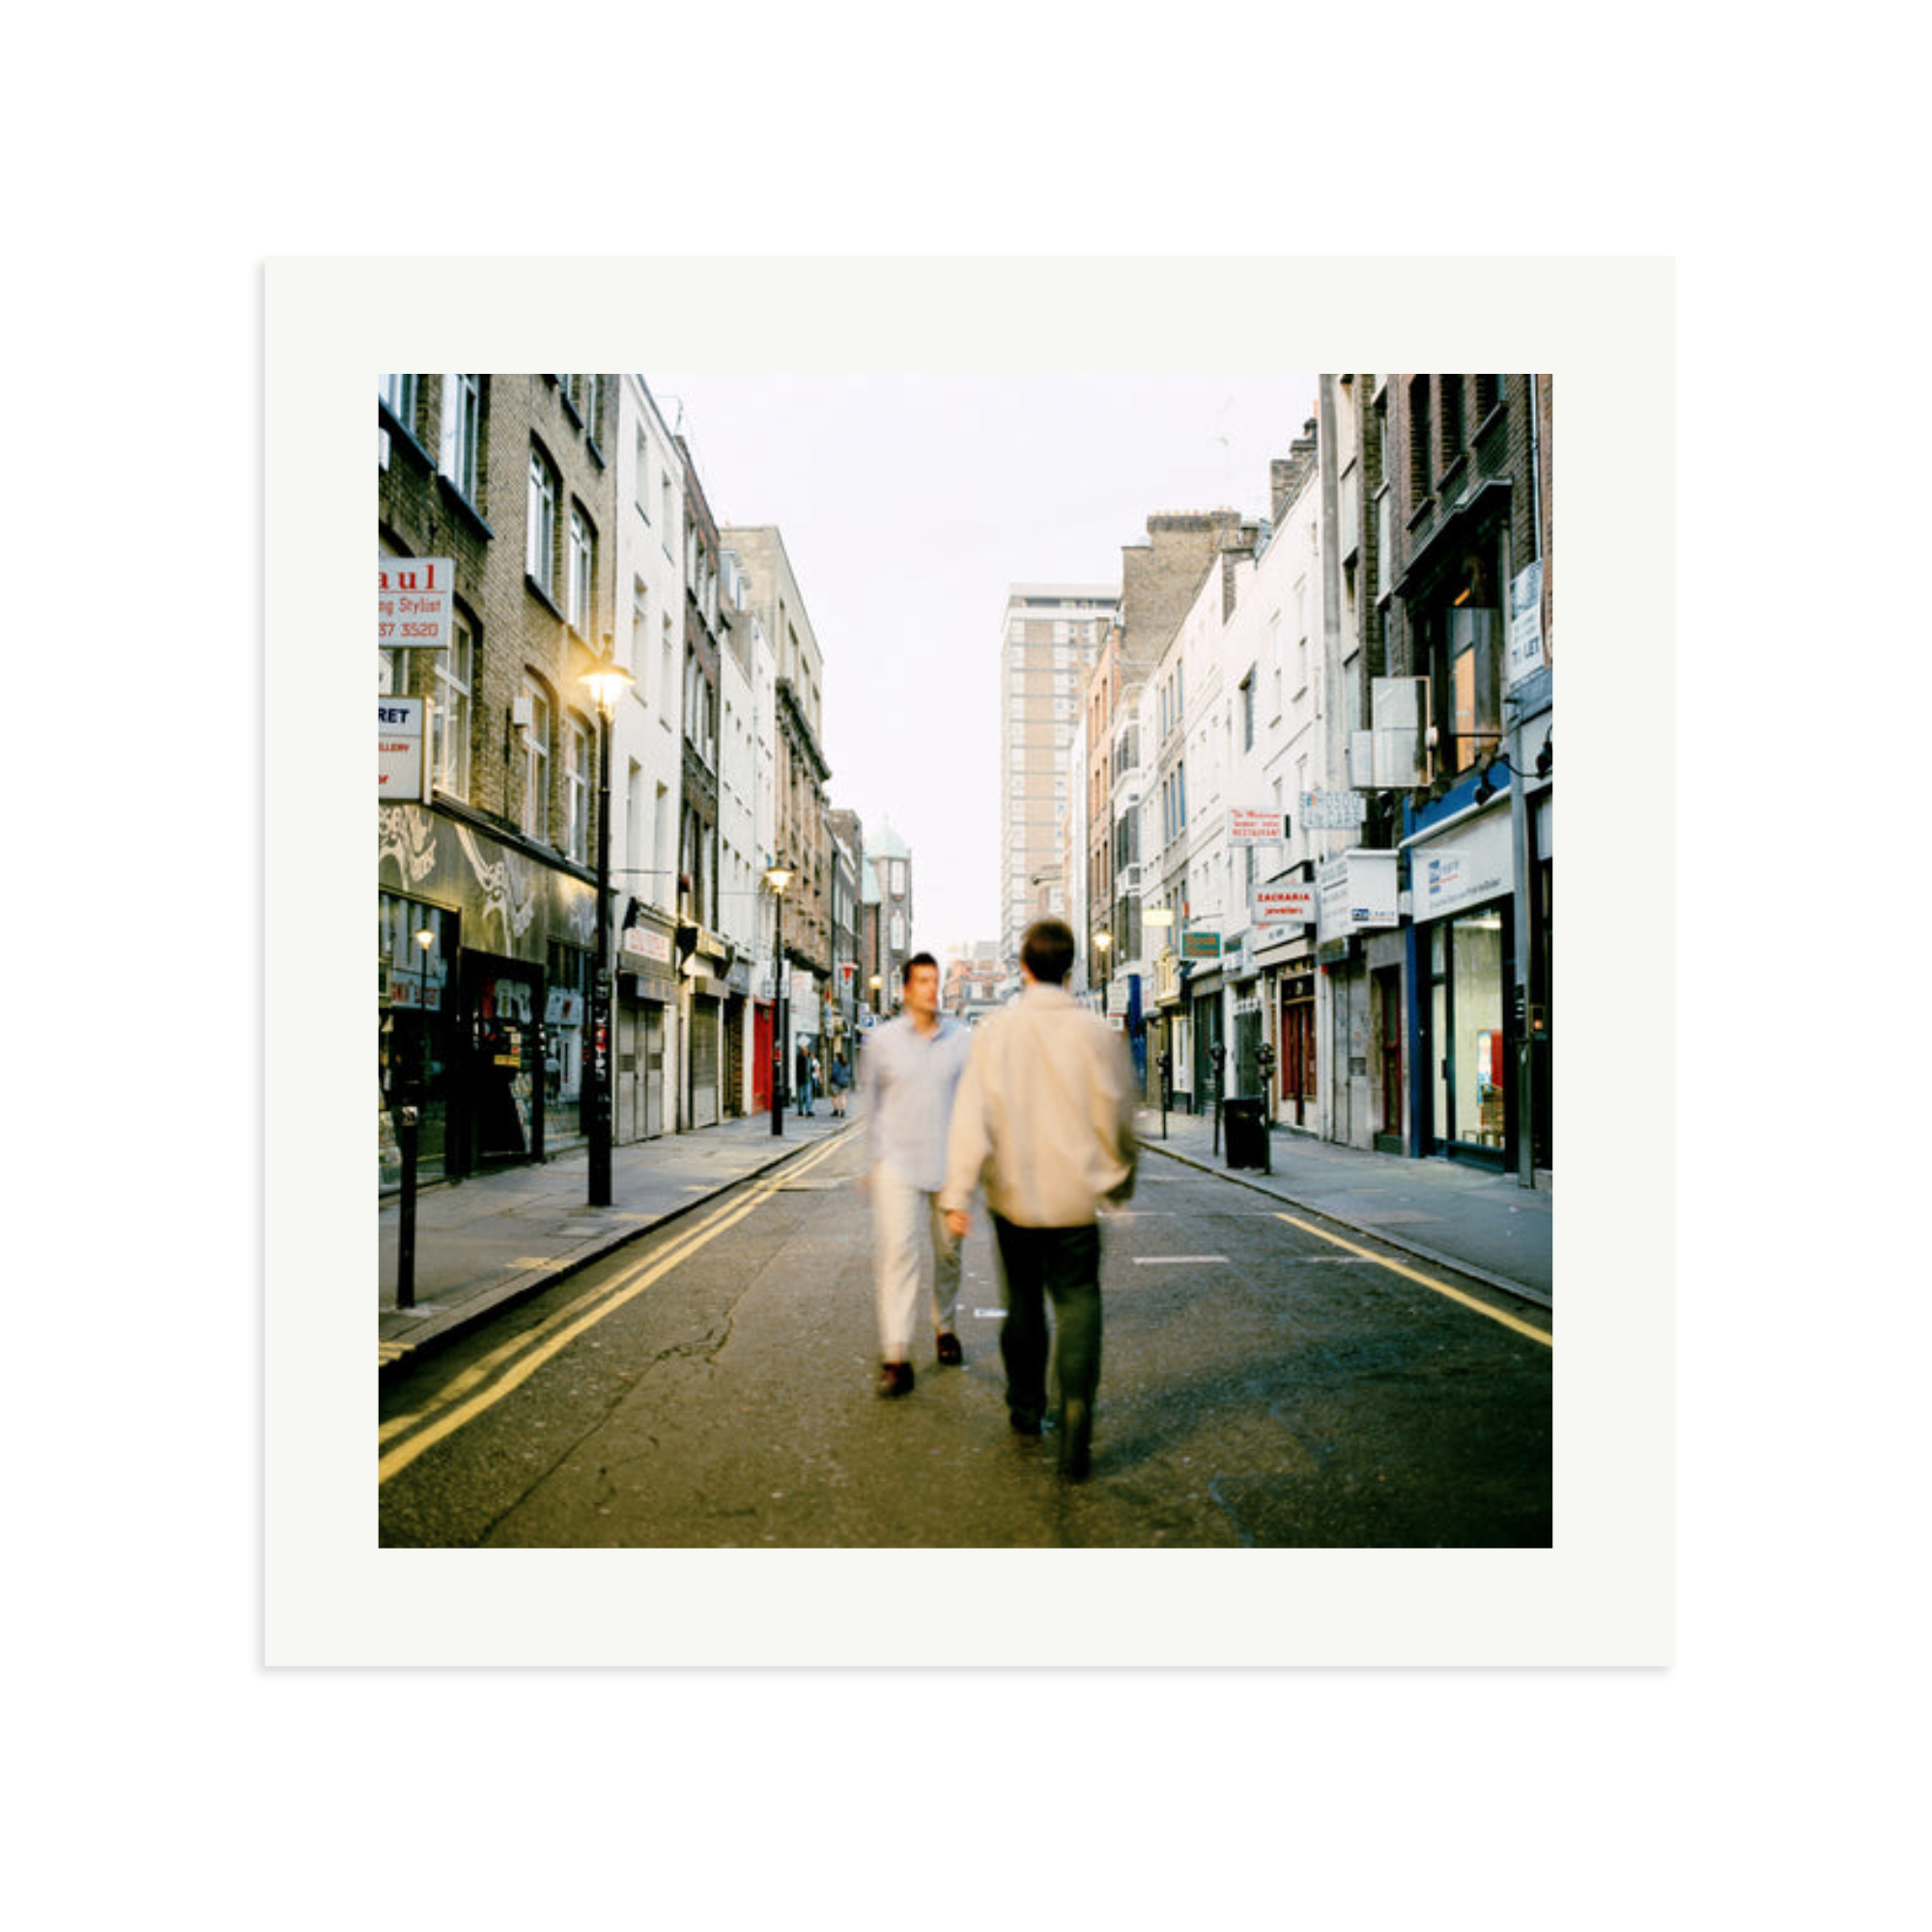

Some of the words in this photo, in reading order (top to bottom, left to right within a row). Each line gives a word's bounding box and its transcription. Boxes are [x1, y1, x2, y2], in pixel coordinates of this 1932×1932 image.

[399, 595, 441, 615] Stylist
[399, 621, 439, 637] 3520
[1264, 904, 1304, 917] jewellers
